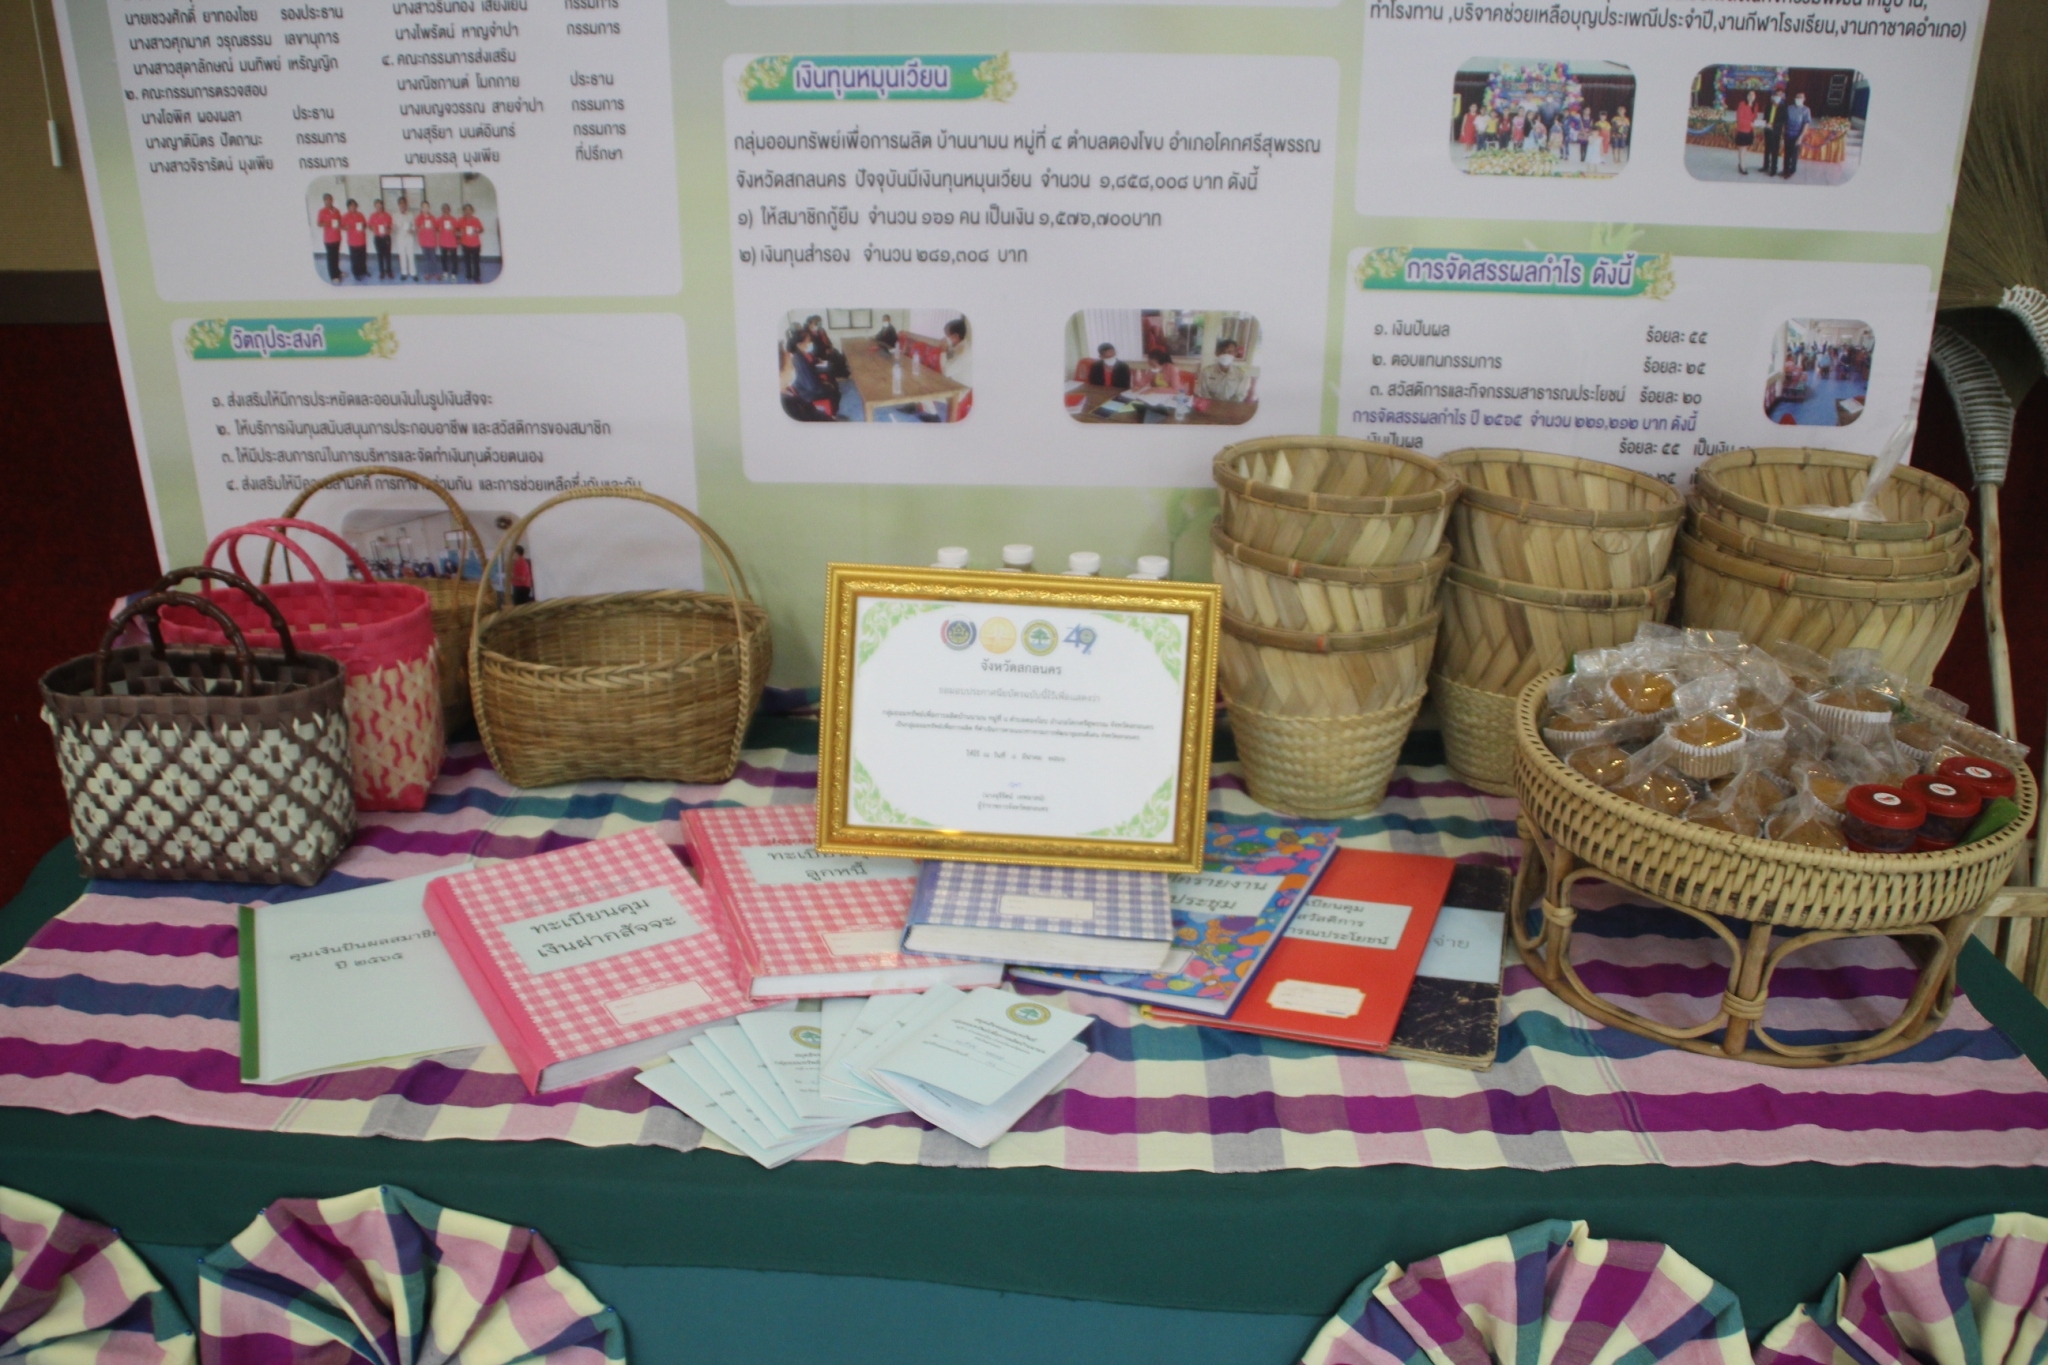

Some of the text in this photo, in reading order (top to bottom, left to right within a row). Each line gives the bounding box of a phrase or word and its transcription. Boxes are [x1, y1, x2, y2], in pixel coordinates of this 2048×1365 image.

[281, 4, 344, 21] รองประธาน
[392, 0, 475, 15] นางสาวรนทอง
[285, 30, 339, 49] เลขานุการ
[395, 20, 620, 41] นางไพรัตน์ หาญจำปา กรรมการ
[133, 58, 234, 79] นางสาวสุดาลักษณ์
[287, 54, 339, 73] เหรัญญิก
[396, 47, 517, 66] คณะกรรมการส่งเสริม
[570, 70, 614, 87] ประธาน
[796, 61, 948, 95] เงินทุนหมุนเวียน
[142, 83, 268, 100] คณะกรรมการตรวจสอบ
[292, 105, 335, 121] ประธาน
[399, 96, 624, 117] นางเบญจวรรณ สายจำปา กรรมการ
[145, 133, 215, 151] นางญาติมิตร
[296, 131, 347, 145] กรรมการ
[402, 123, 453, 144] นางสุริยา
[573, 122, 626, 137] กรรมการ
[734, 125, 932, 156] กลุ่มออมทรัพย์เพื่อการผลิต
[937, 129, 1008, 150] บ้านนามน
[1014, 125, 1046, 155] หมู่ที่
[1067, 129, 1164, 151] ตำบลตองโขบ
[1169, 131, 1320, 158] อำเภอโคกศรีสุพรรณ
[149, 155, 234, 174] นางสาวจิรารัตน์
[299, 155, 349, 169] กรรมการ
[405, 150, 458, 168] นายบรรลุ
[575, 141, 623, 161] ที่ปรึกษา
[736, 169, 846, 188] จังหวัดสกลนคร
[856, 168, 1031, 193] ปัจจุบันมีเงินทุนหมุนเวียน
[1041, 168, 1090, 188] จำนวน
[1193, 174, 1222, 189] บาท
[1228, 165, 1260, 191] ดังนี้
[737, 209, 753, 228] ๑)
[761, 205, 858, 232] ให้สมาชิกกู้ยืม
[869, 205, 917, 226] จำนวน
[959, 210, 980, 226] คน
[985, 203, 1034, 226] เป็นเงิน
[739, 248, 757, 267] ๒)
[760, 243, 851, 269] เงินทุนสำรอง
[864, 243, 912, 263] จำนวน
[998, 247, 1028, 263] บาท
[1406, 252, 1637, 287] การจัดสรรผลกำไร ดังนี้
[231, 324, 325, 356] วัตถุประสงค์
[1392, 320, 1450, 337] เงินปันผล
[1646, 326, 1685, 344] ร้อยละ
[1391, 354, 1502, 369] ตอบแทนกรรมการ
[1643, 356, 1682, 374] ร้อยละ
[227, 389, 493, 411] ส่งเสริมให้มีการประหยัดและออมเงินในรูปเงินสัจจะ
[1388, 381, 1626, 401] สวัสดิการและกิจกรรมสาธารณประโยชน์
[1640, 386, 1678, 404] ร้อยละ
[235, 417, 467, 440] ให้บริการเงินทุนสนับสนุนการประกอบอาชีพ
[472, 418, 611, 436] และสวัสดิการของสมาชิก
[1353, 407, 1466, 425] การจัดสรรผลกำไร
[1470, 410, 1480, 424] ปี
[1531, 410, 1571, 428] จำนวน
[1643, 417, 1667, 430] บาท
[1671, 410, 1698, 431] ดังนี้
[1619, 437, 1658, 455] ร้อยละ
[981, 659, 1062, 675] จังหวัดสกลนคร
[806, 861, 868, 882] ลูกหนี้
[530, 898, 649, 935] ทะเบียนคุม
[537, 916, 677, 958] เงินฝากสัจจะ
[335, 959, 347, 970] ปี
